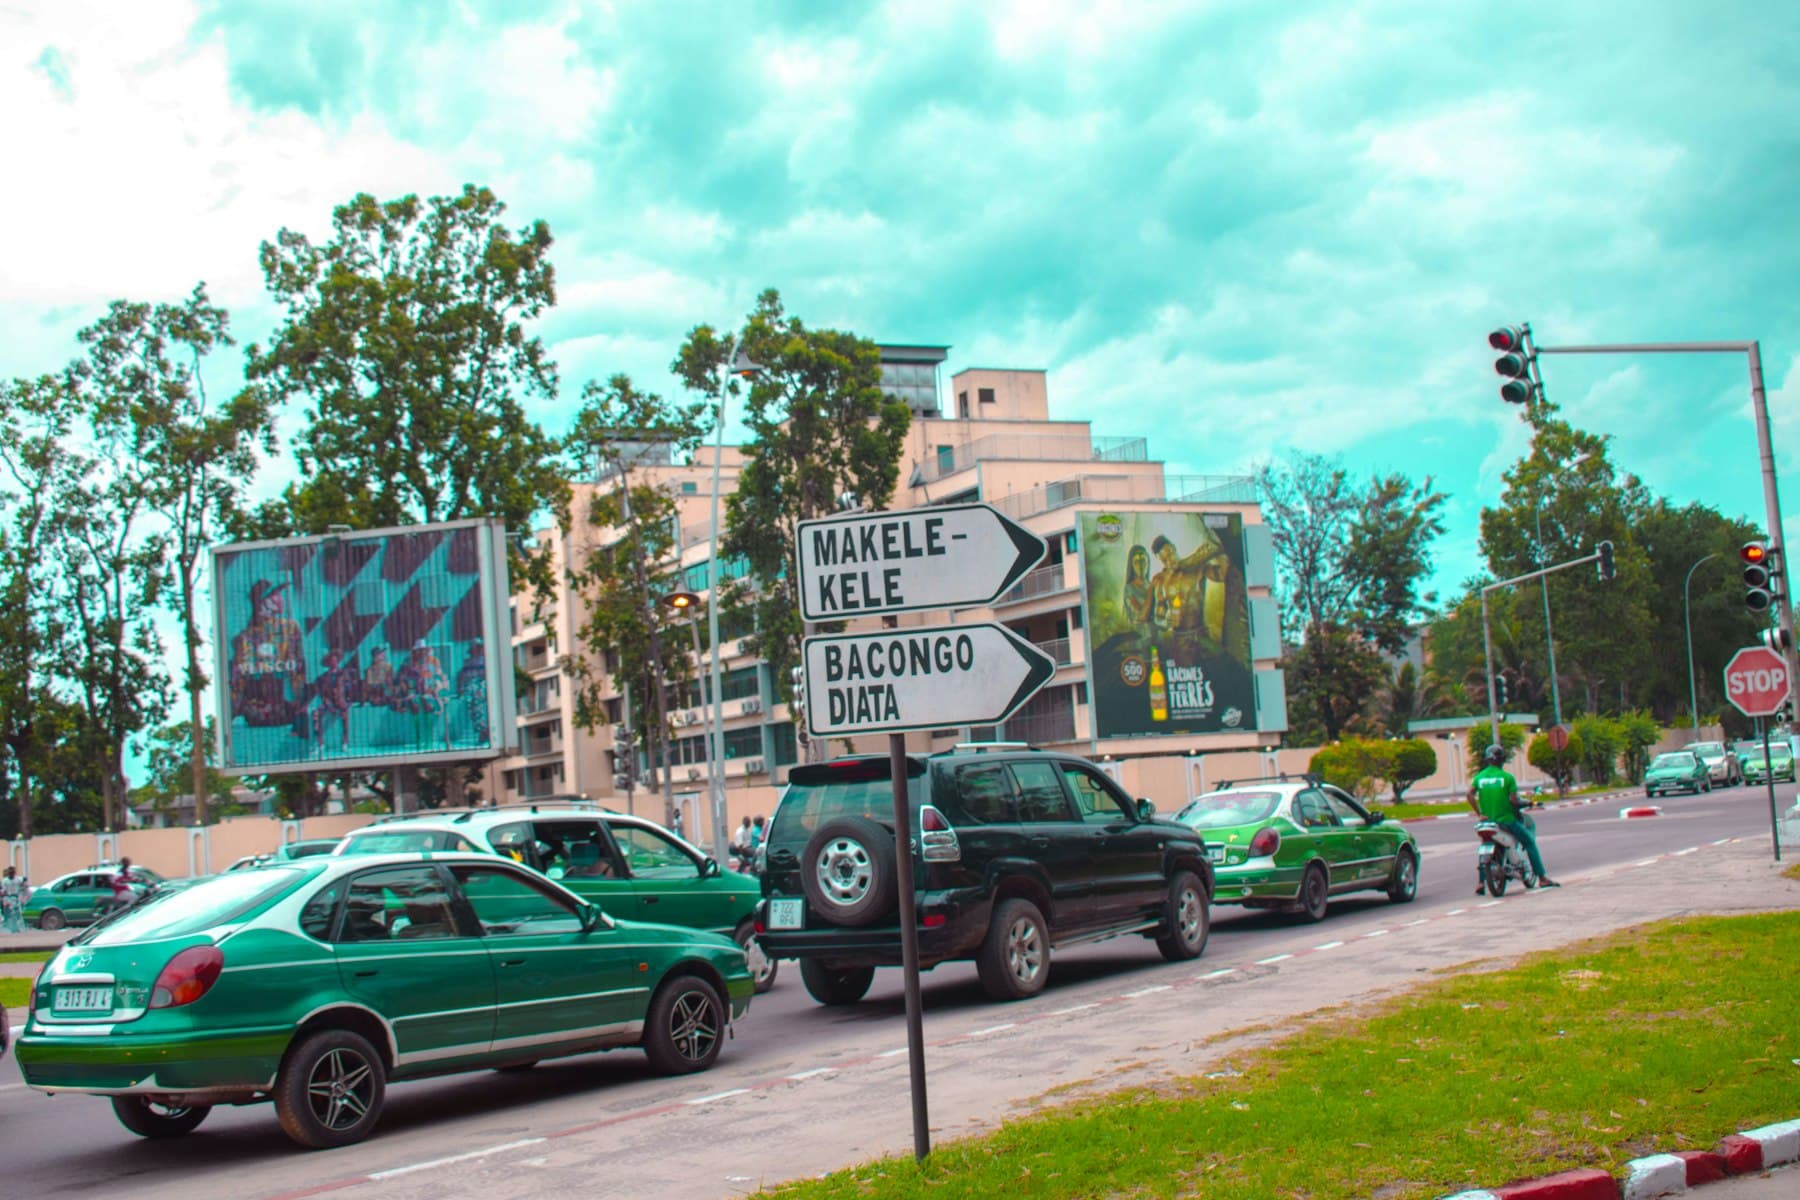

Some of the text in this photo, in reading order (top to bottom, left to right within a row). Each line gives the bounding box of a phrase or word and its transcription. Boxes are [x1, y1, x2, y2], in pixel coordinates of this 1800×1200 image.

[819, 568, 904, 612] KELE
[825, 634, 974, 682] BACONGO
[1123, 664, 1143, 677] 500
[1729, 668, 1785, 695] STOP
[828, 684, 900, 726] DIATA
